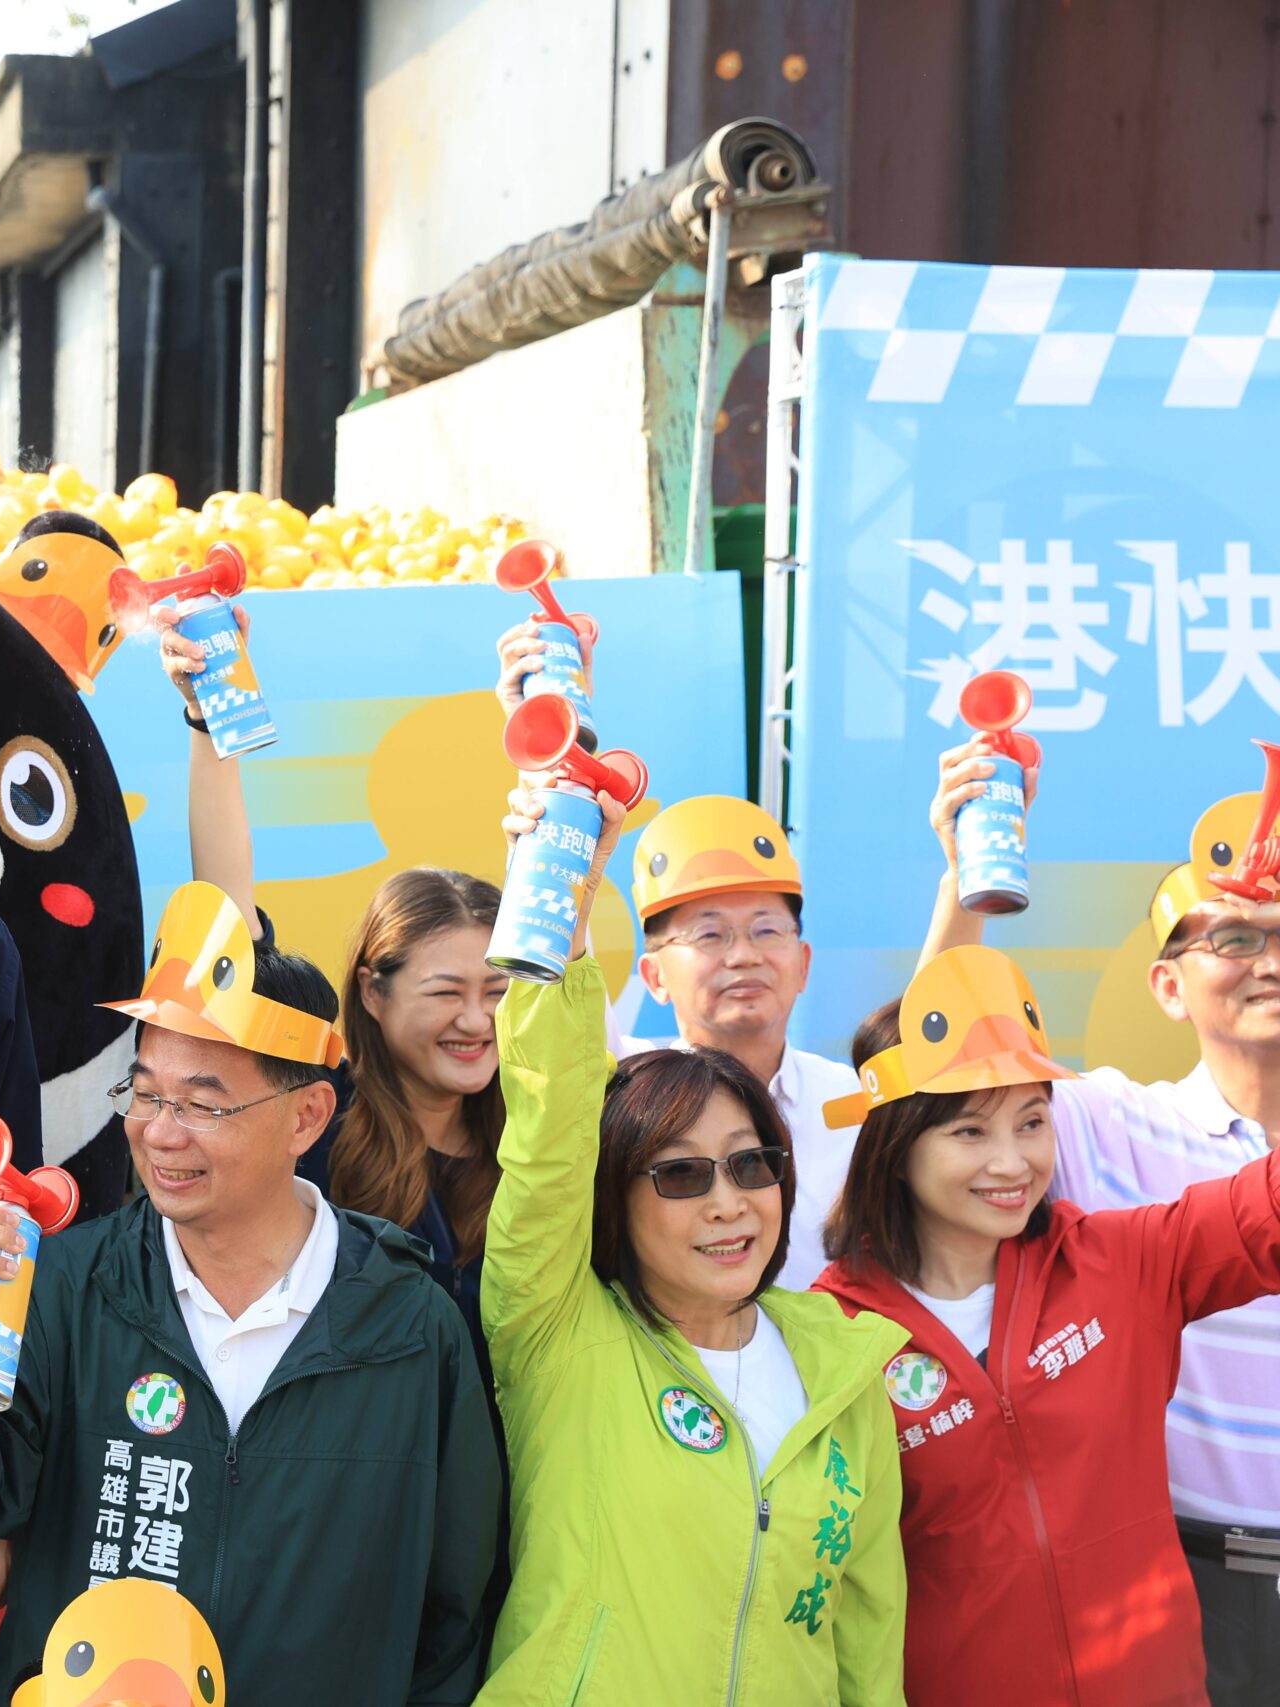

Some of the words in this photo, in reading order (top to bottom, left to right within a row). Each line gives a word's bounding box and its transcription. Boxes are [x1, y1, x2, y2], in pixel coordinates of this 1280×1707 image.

[1040, 1316, 1106, 1380] 李雅慧
[126, 1455, 194, 1592] 郭建
